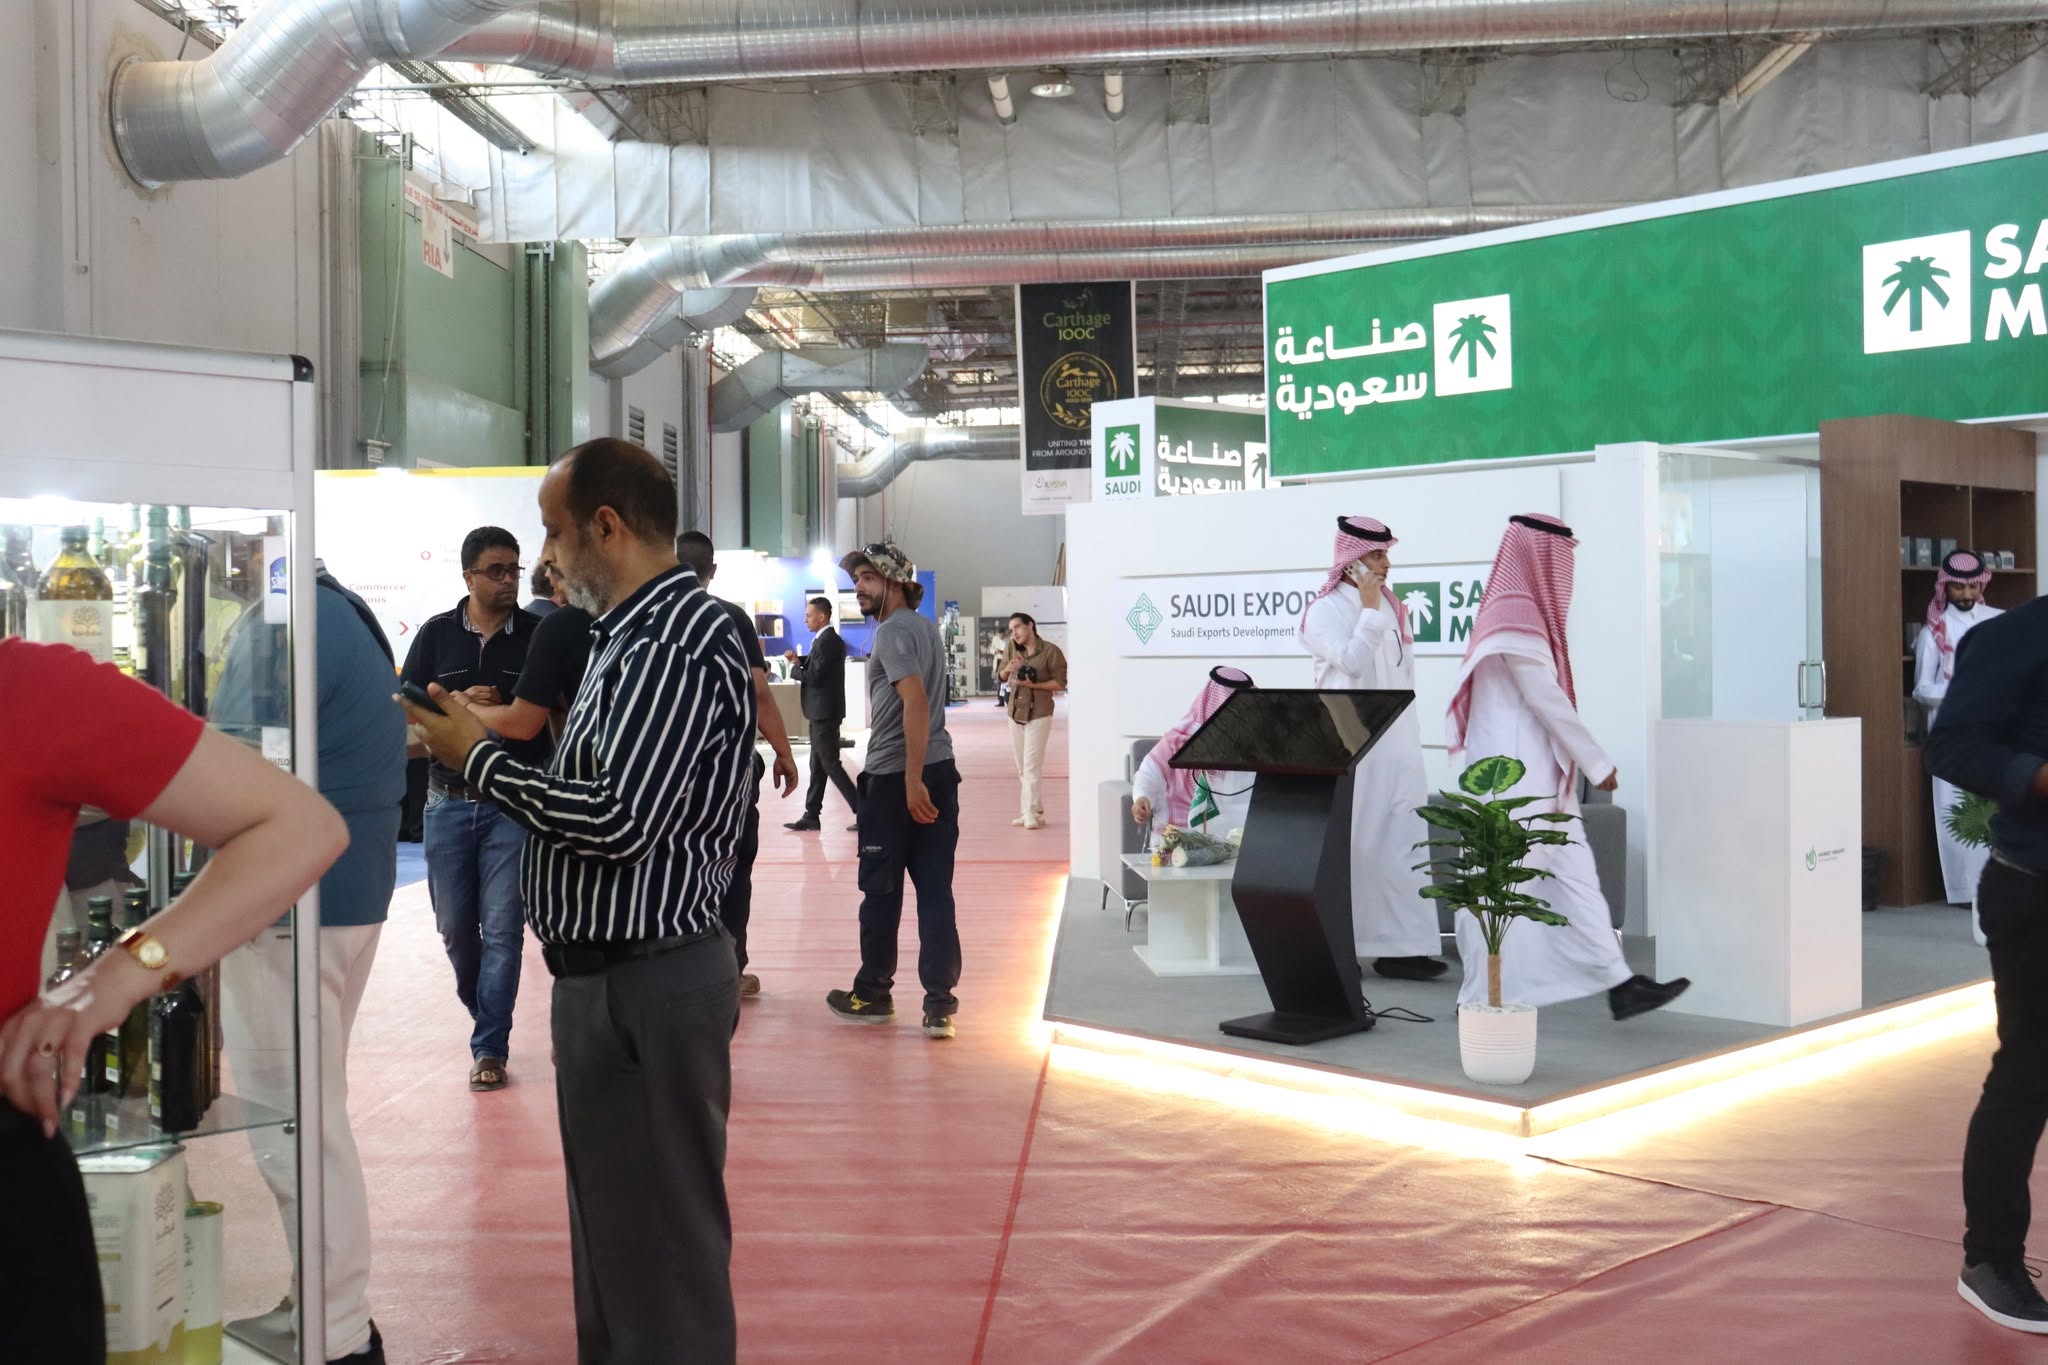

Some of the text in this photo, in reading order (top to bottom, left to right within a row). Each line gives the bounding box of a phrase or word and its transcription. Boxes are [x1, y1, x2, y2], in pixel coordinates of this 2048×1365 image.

[424, 239, 442, 270] RIA
[1043, 311, 1111, 328] Carthage
[1274, 318, 1427, 365] صناعة
[1056, 377, 1101, 389] Carthage
[1275, 371, 1428, 420] سعودية
[1048, 439, 1078, 448] UNITING
[1157, 434, 1242, 467] صناعة
[1032, 449, 1054, 457] FROM
[1055, 448, 1087, 457] AROUND
[1105, 480, 1141, 496] SAUDI
[349, 582, 407, 592] Commerce
[1170, 593, 1235, 618] SAUDI
[1171, 625, 1295, 640] Saudi Exports Development
